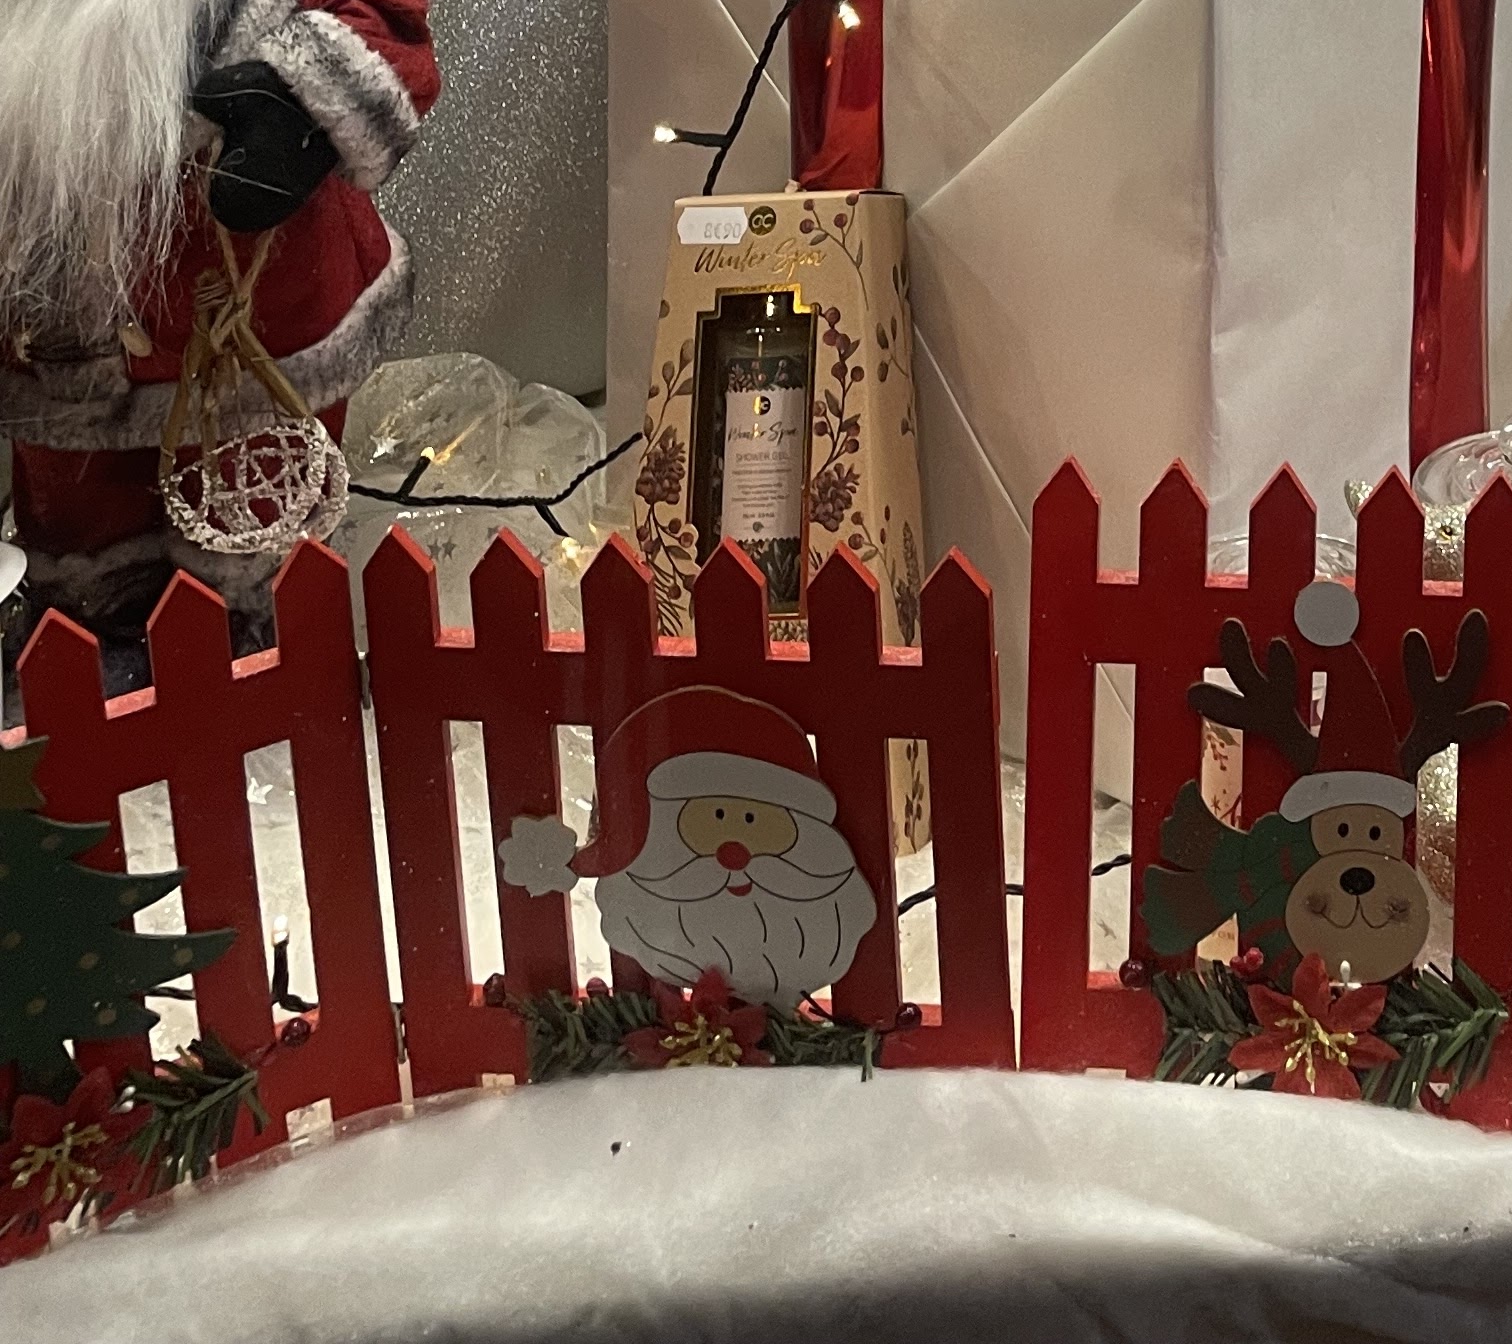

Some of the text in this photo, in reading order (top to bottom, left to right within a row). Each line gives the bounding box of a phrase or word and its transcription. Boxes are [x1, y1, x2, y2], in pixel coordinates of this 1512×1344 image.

[703, 222, 742, 240] 8€90
[693, 237, 827, 282] Winter Spa
